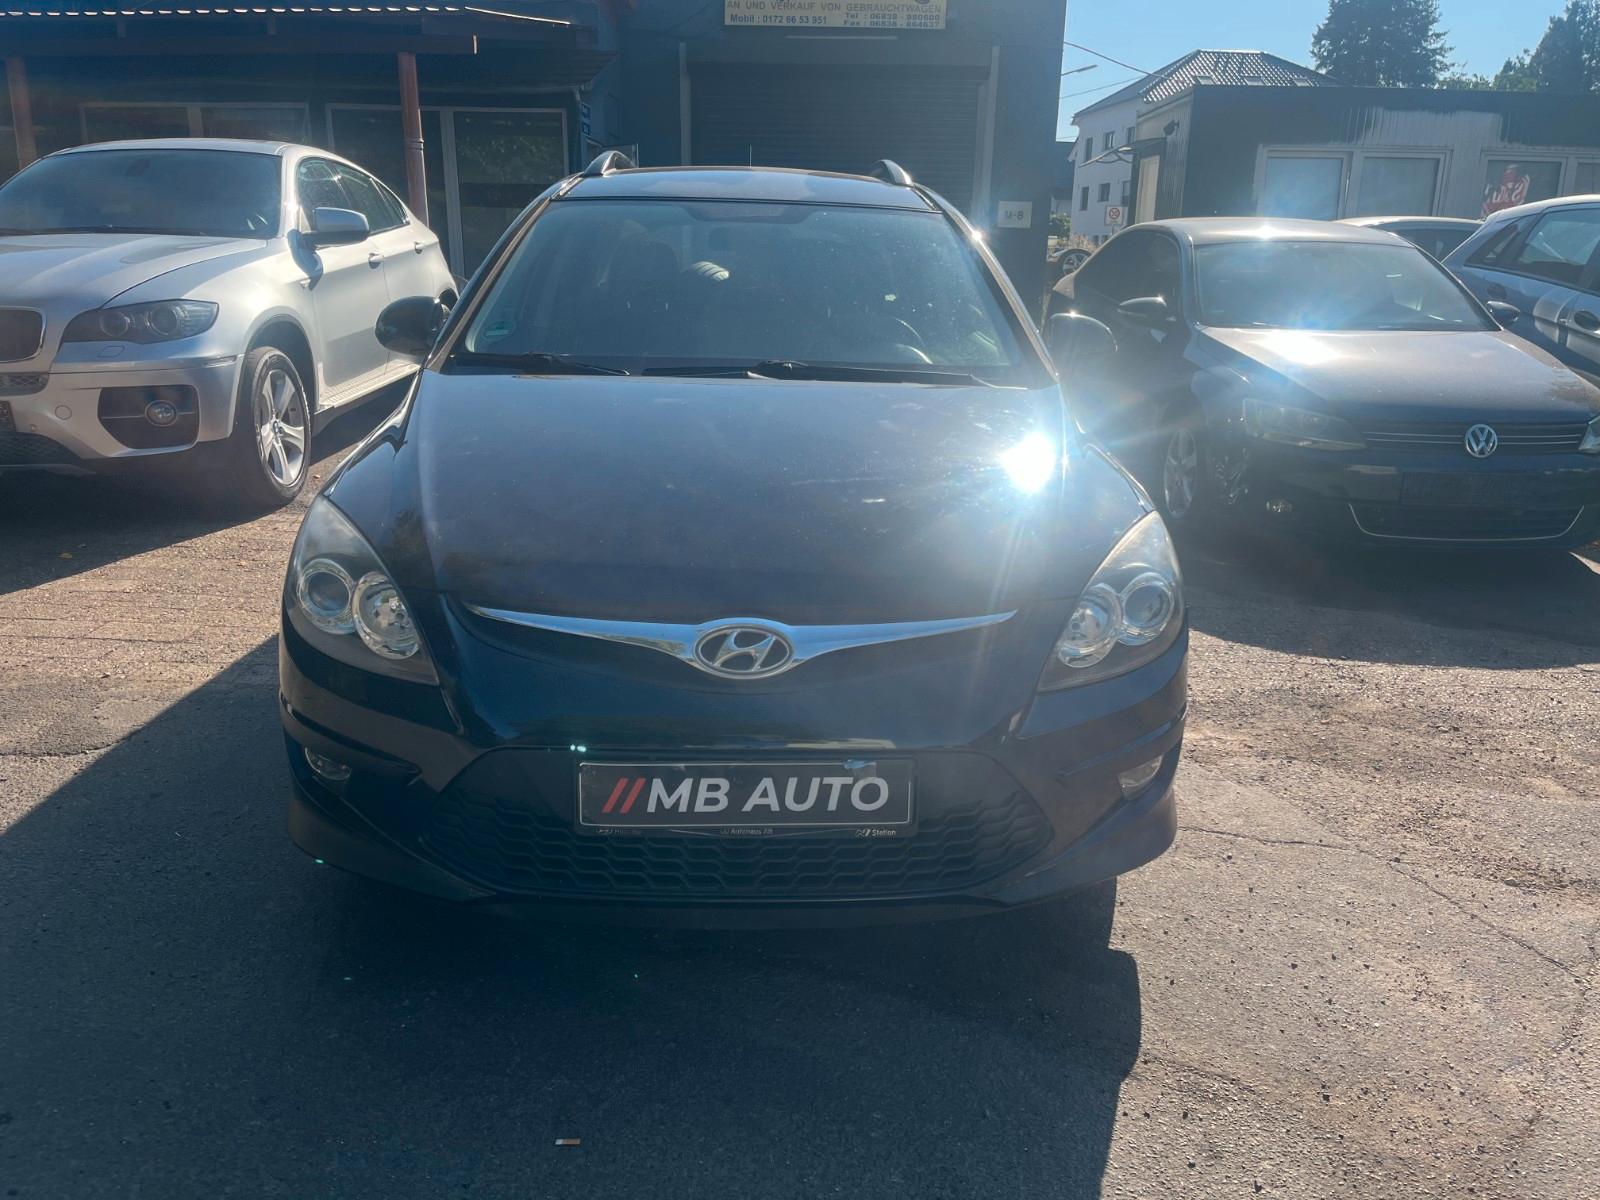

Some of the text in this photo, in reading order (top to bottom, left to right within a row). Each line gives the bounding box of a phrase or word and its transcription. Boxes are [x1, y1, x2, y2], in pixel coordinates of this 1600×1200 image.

[727, 1, 942, 13] AN UND VERKAUF VON GEBRAUCHTWAGEN
[730, 14, 755, 23] Mobil
[762, 15, 783, 24] 0172
[799, 16, 809, 24] 53
[741, 776, 889, 812] AUTO
[871, 829, 897, 837] Station
